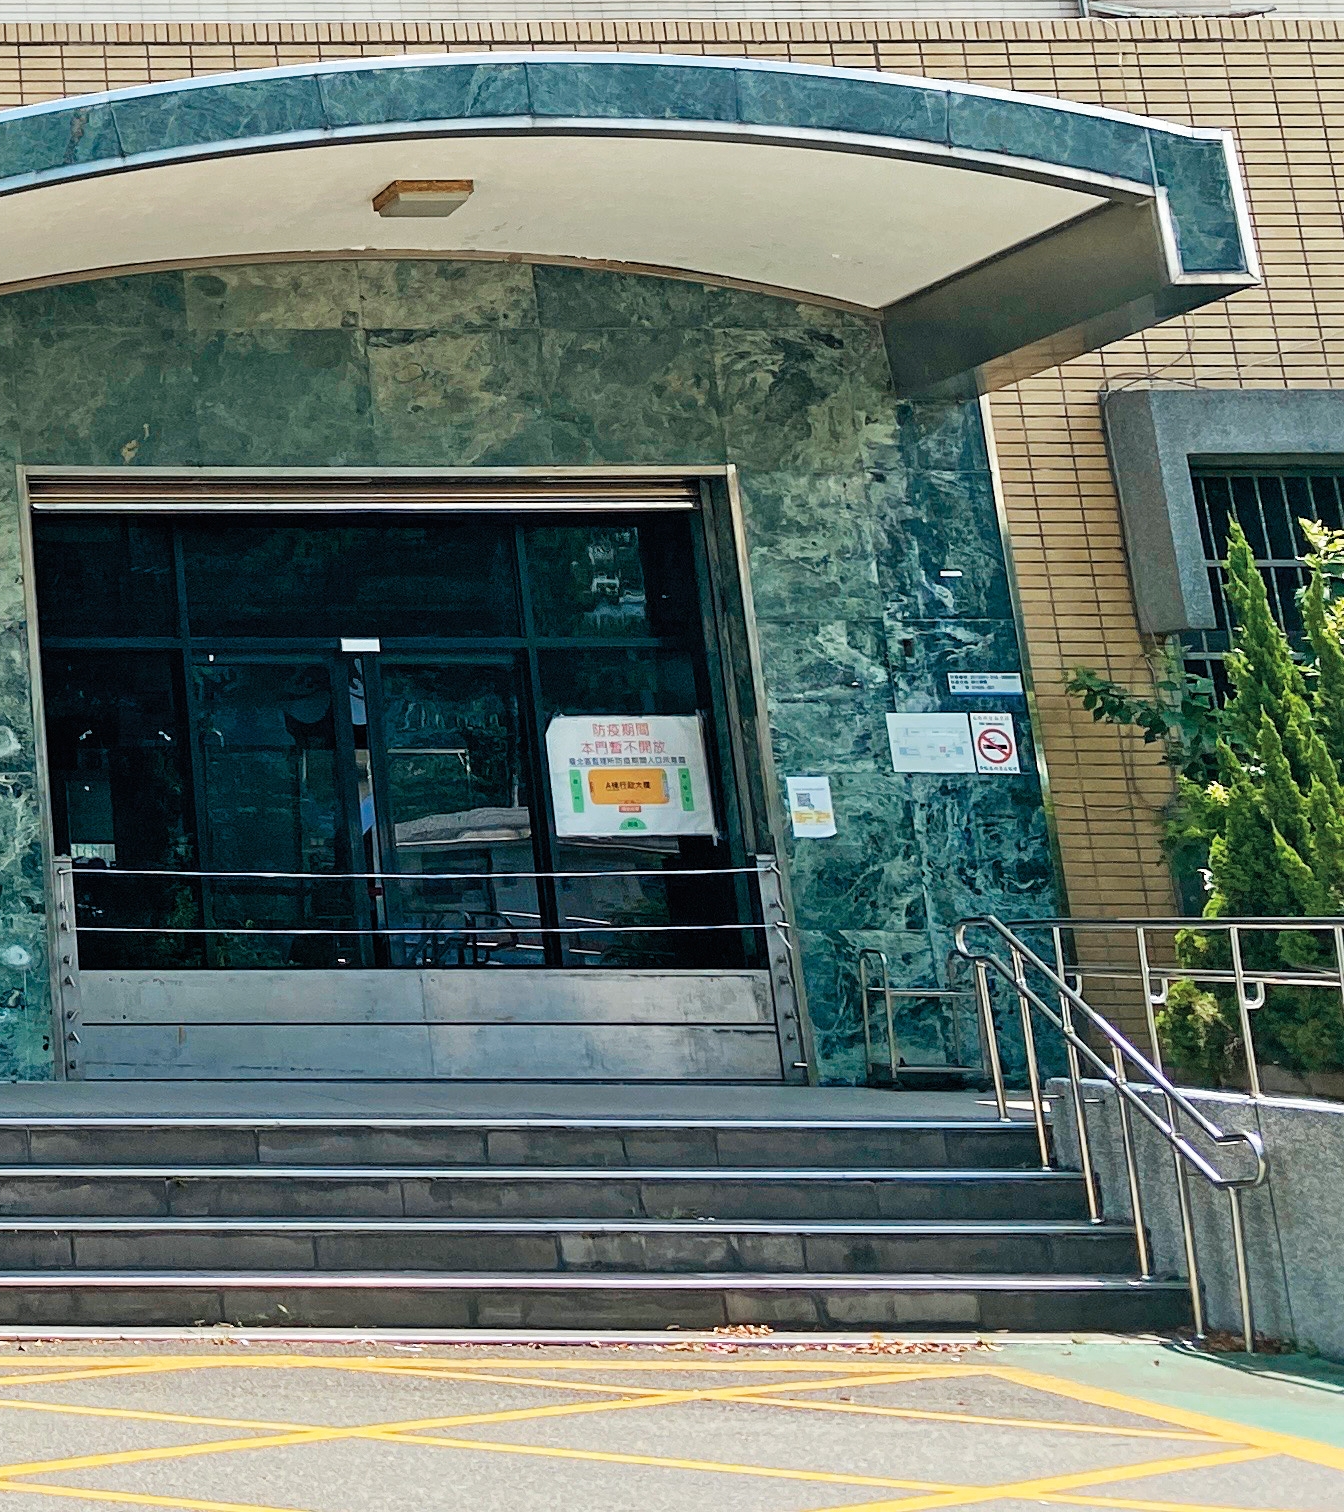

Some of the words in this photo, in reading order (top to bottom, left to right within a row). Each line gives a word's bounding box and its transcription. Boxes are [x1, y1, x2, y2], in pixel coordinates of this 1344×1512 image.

[592, 723, 649, 737] 防疫期間
[581, 740, 666, 755] 本門暫不開放
